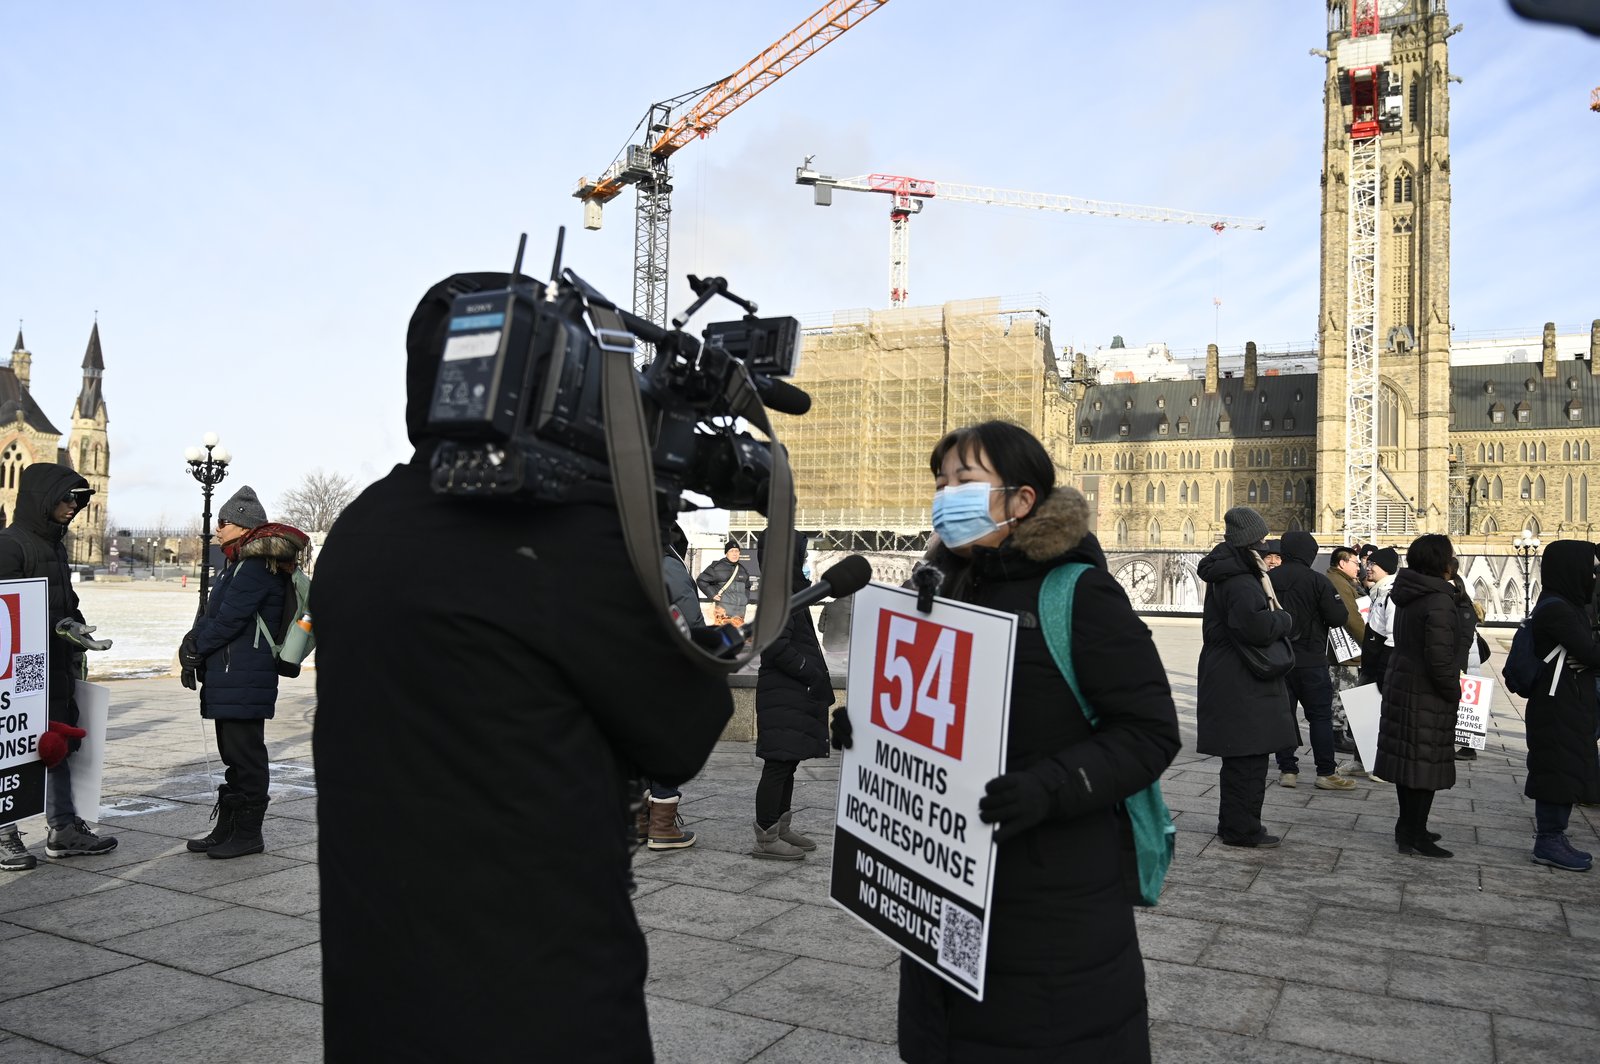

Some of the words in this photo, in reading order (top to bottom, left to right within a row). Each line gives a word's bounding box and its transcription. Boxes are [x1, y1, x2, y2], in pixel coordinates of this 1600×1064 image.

[880, 614, 957, 751] 54
[1461, 680, 1477, 704] 8
[0, 712, 28, 735] FOR
[1466, 714, 1480, 722] FOR
[876, 739, 947, 795] MONTHS
[858, 765, 924, 822] WAITING
[929, 801, 967, 843] FOR
[846, 793, 878, 833] IRCC
[879, 815, 976, 887] RESPONSE
[855, 849, 874, 877] NO
[859, 880, 877, 909] NO
[879, 892, 941, 950] RESULTS
